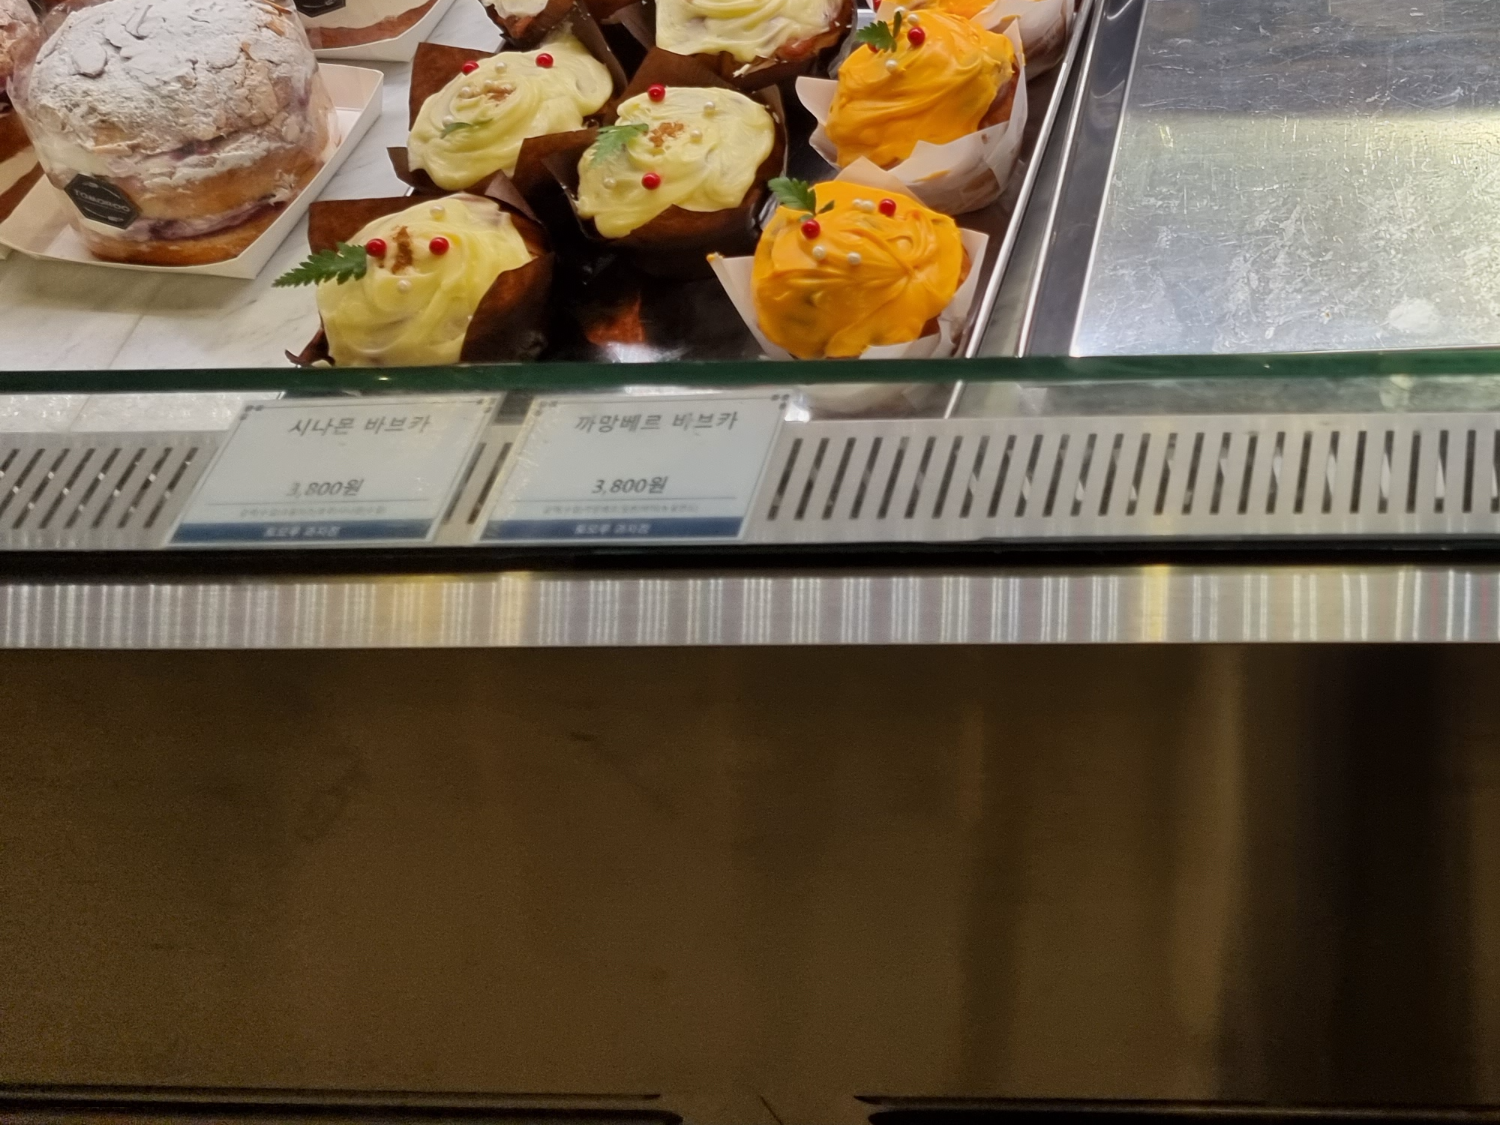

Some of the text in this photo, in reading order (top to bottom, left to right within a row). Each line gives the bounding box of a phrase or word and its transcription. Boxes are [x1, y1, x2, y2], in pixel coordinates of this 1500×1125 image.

[74, 189, 130, 212] TOMOROO
[288, 415, 431, 436] 시나몬 바브카
[575, 412, 738, 433] 까망베르 바브카
[286, 479, 364, 498] 3,800원
[591, 476, 668, 495] 3,800원
